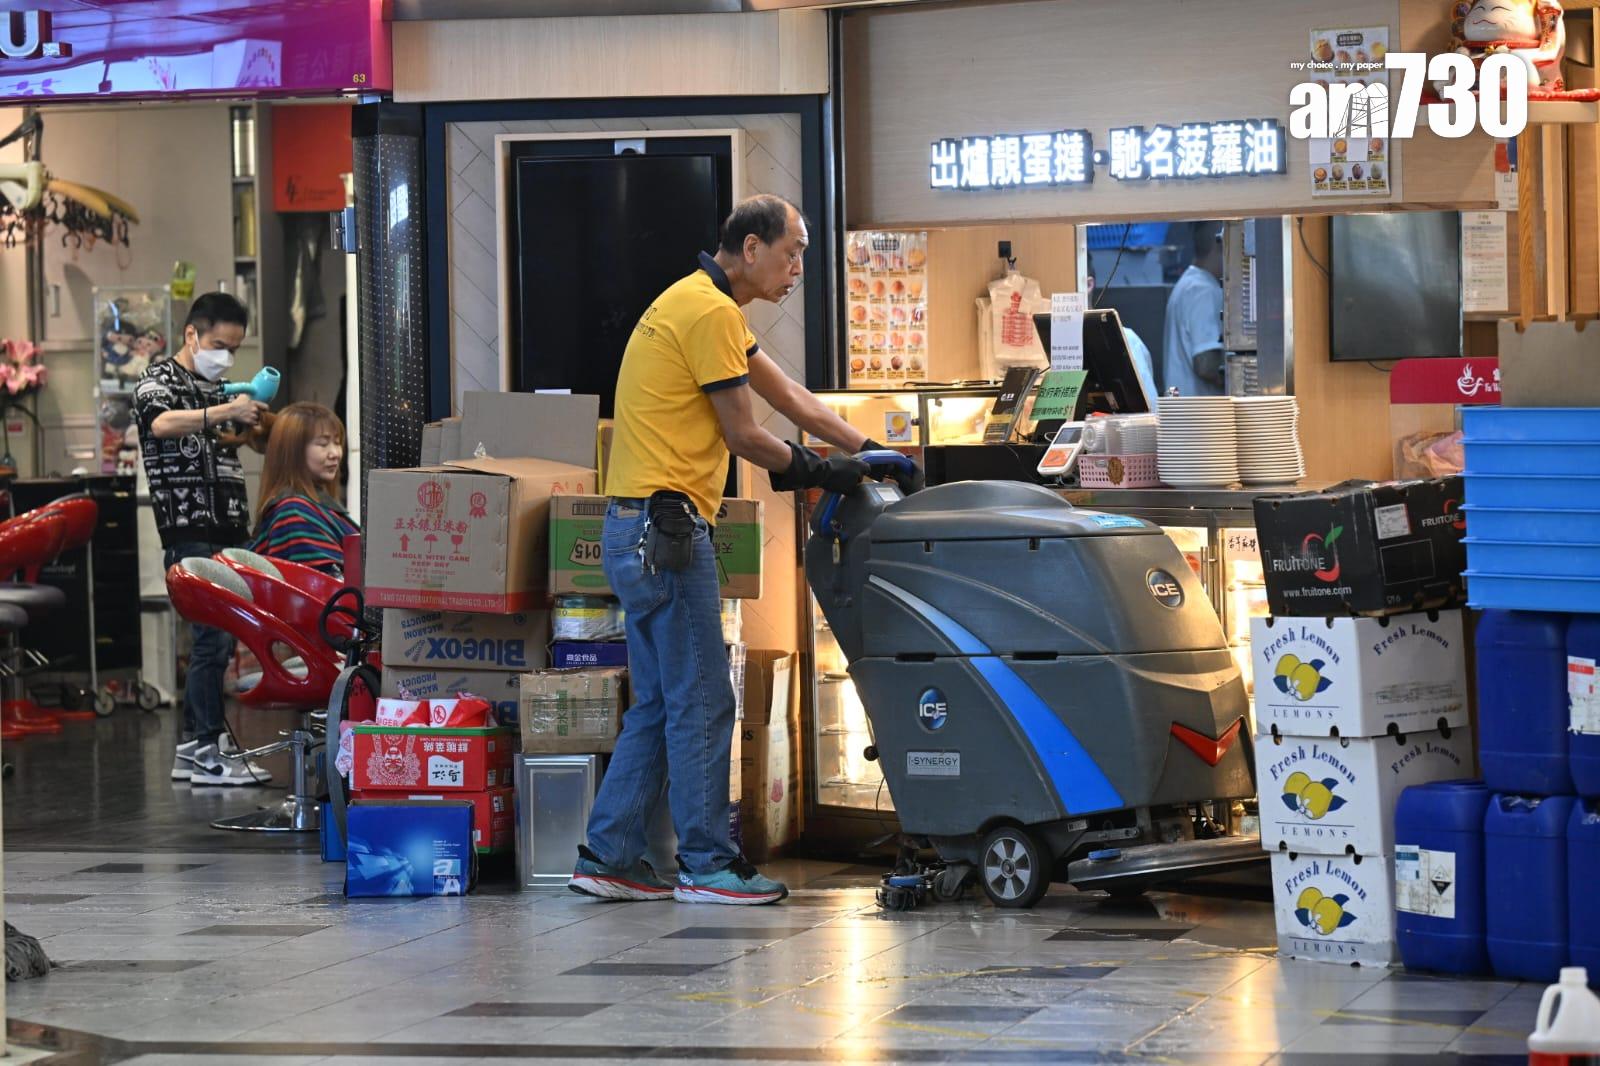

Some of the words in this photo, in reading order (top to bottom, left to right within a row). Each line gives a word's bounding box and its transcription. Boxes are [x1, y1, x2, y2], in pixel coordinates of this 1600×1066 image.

[1421, 512, 1460, 528] FRUITONE
[426, 554, 446, 562] WITH
[1273, 556, 1326, 573] FRUITONE
[1150, 583, 1180, 596] ICE
[1283, 585, 1352, 598] www.fruitone.com
[403, 623, 443, 640] MACARONI
[1263, 627, 1296, 663] Fresh
[1301, 625, 1341, 666] Lemon
[1373, 626, 1407, 656] Fresh
[1411, 624, 1449, 649] Lemon
[919, 703, 947, 717] ICE
[1273, 708, 1334, 719] LEMONS
[1269, 745, 1306, 781] Fresh
[1312, 744, 1357, 785] Lemon
[1391, 744, 1423, 775] Fresh
[1426, 742, 1460, 766] Lemon
[1281, 826, 1348, 838] LEMONS
[1284, 861, 1320, 896] Fresh
[1326, 860, 1368, 901] Lemon
[1294, 941, 1357, 955] LEMONS
